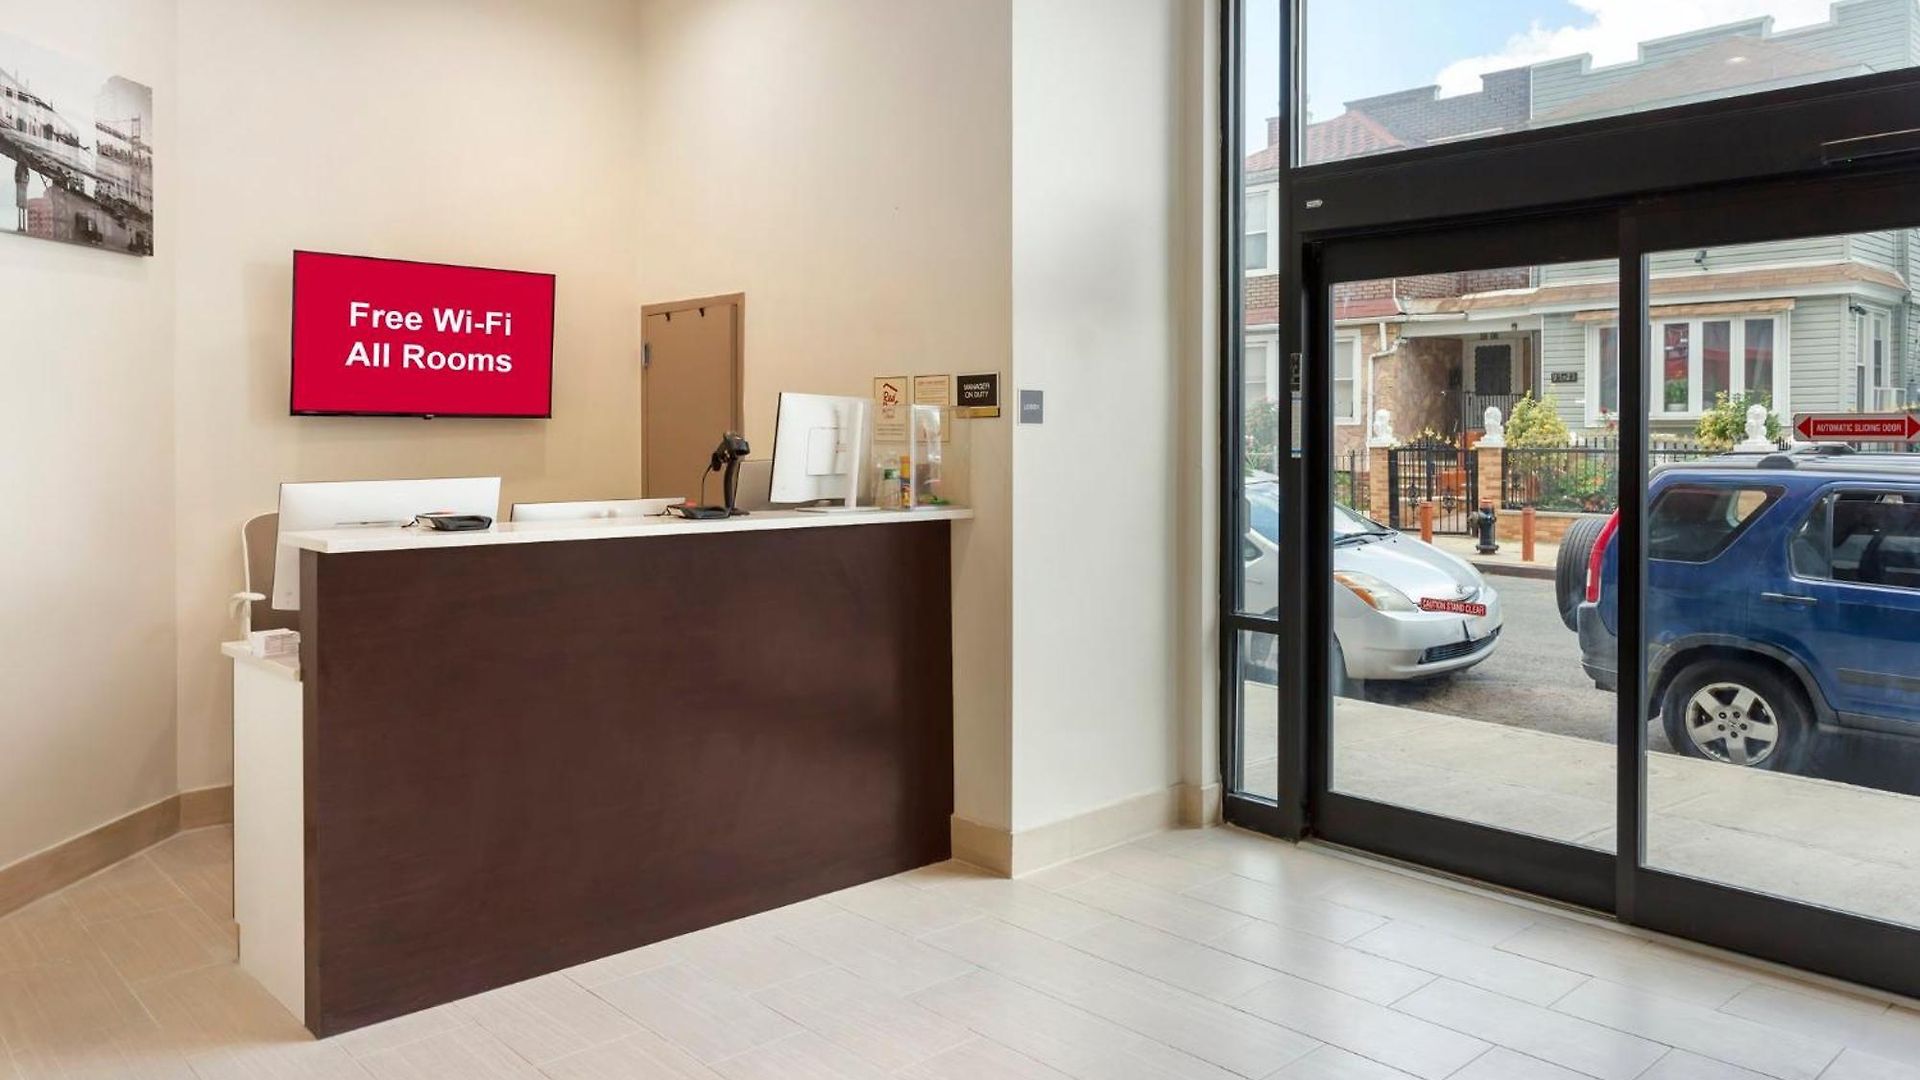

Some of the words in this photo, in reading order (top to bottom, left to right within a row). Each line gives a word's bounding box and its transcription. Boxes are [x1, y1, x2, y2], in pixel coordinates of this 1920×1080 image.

[351, 301, 423, 331] Free
[433, 308, 512, 336] Wi-Fi
[345, 341, 390, 368] All
[403, 344, 512, 373] Rooms
[964, 383, 990, 391] MANAGER
[965, 391, 974, 399] ON
[1816, 423, 1852, 432] AUTOMATIC
[1855, 423, 1880, 432] SLIDING
[1882, 423, 1902, 432] DOOR
[1423, 599, 1446, 611] CAUTION
[1446, 602, 1465, 612] STAND
[1465, 604, 1485, 615] CLEAR
